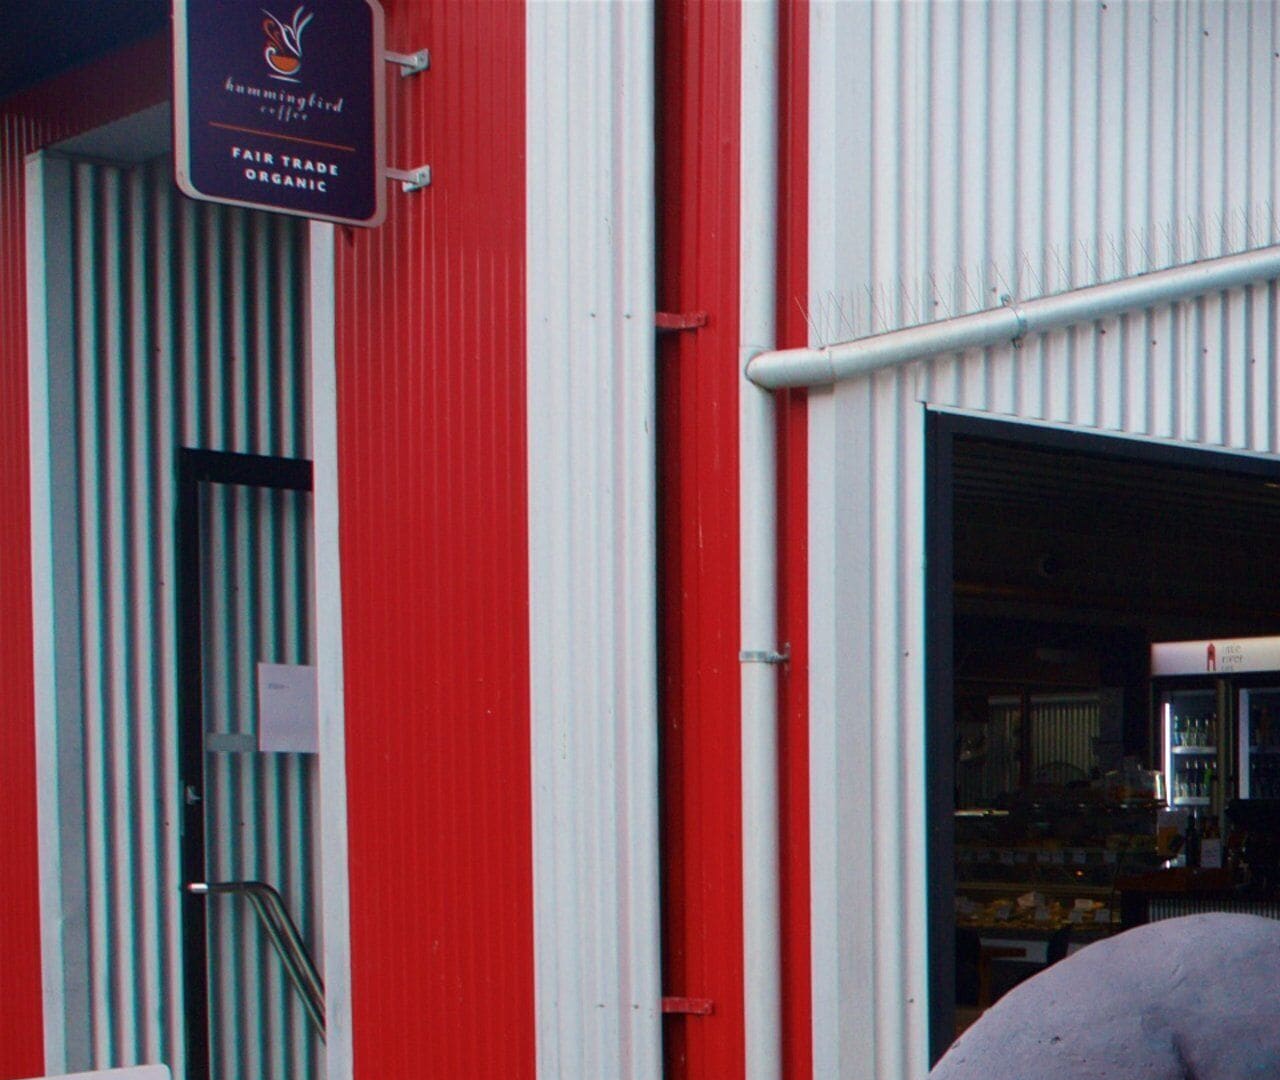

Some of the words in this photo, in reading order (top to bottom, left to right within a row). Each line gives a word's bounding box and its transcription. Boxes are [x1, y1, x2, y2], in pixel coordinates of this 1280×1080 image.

[225, 78, 344, 112] hummingbird
[260, 105, 308, 122] coffee
[232, 147, 274, 165] FAIR
[283, 155, 339, 176] TRADE
[245, 169, 327, 192] ORGANIC
